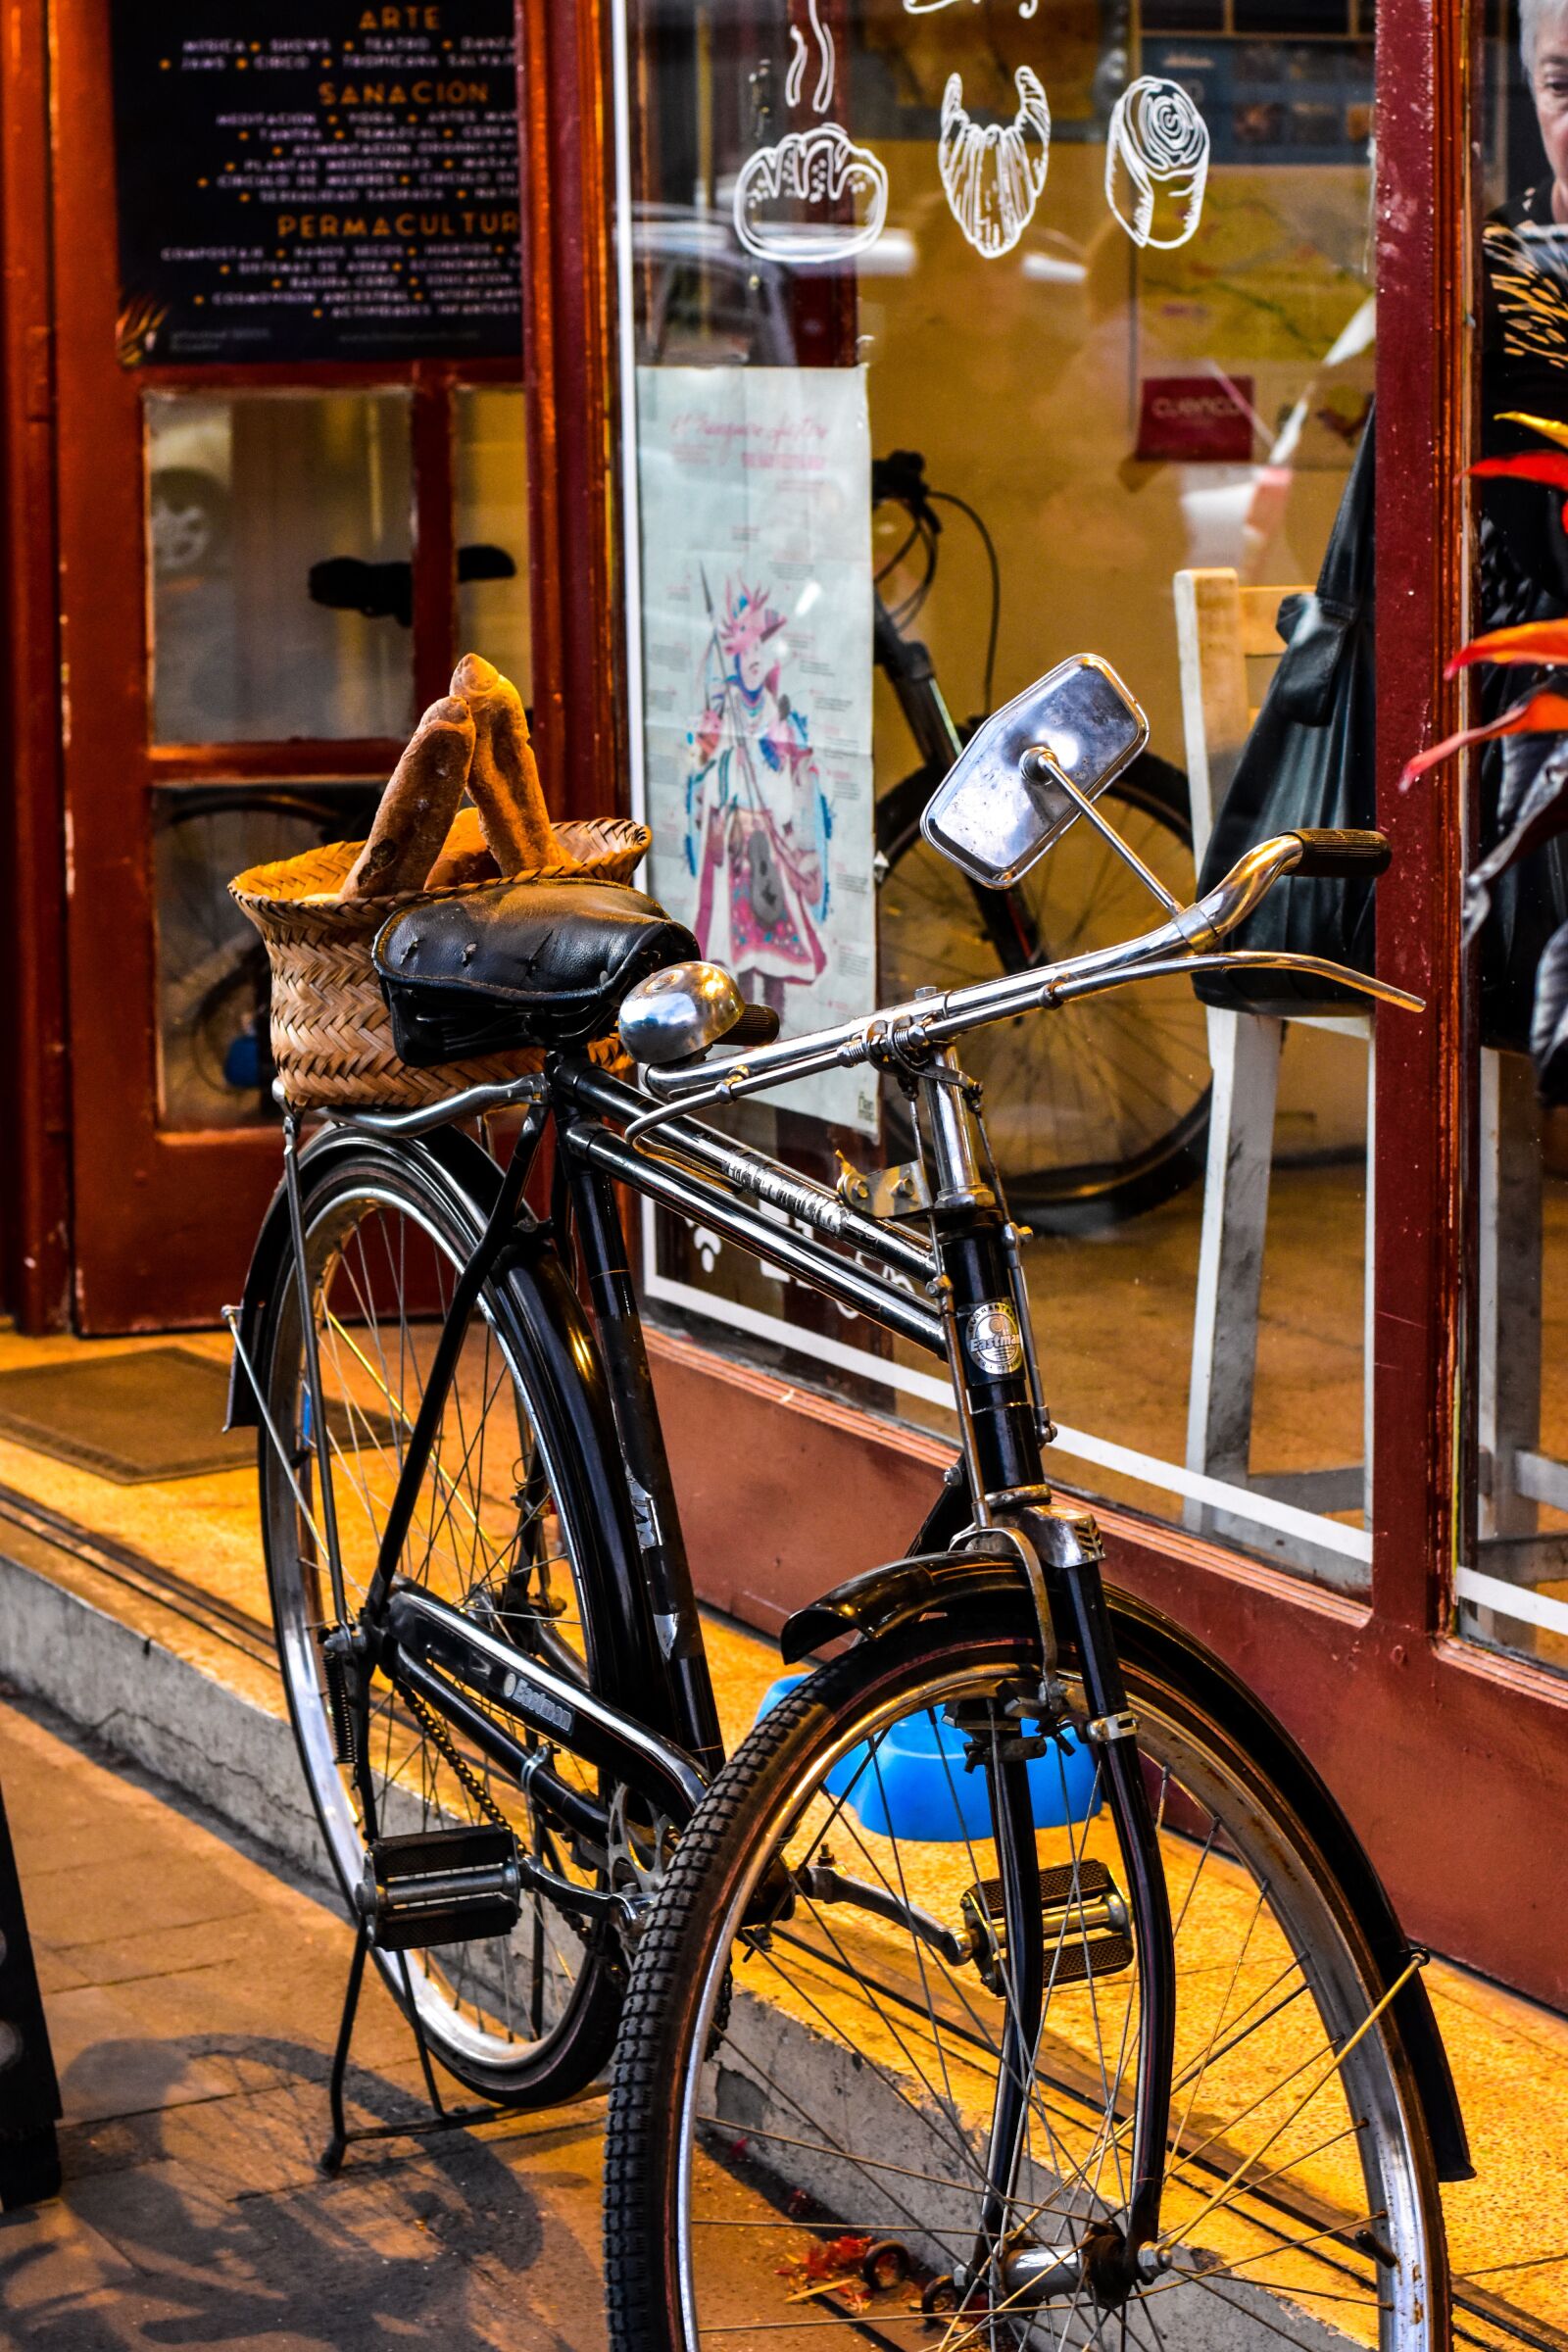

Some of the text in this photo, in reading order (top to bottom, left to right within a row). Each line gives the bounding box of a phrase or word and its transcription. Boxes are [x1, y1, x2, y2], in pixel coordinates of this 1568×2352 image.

[359, 5, 440, 30] ARTE
[270, 38, 331, 53] SHOWS
[364, 36, 430, 52] TEATRO
[253, 55, 310, 70] CIRCO
[342, 54, 440, 69] TROPICANA
[347, 112, 395, 124] YOGA
[426, 110, 476, 123] ARTES
[259, 127, 323, 141] TANTRA
[243, 158, 319, 172] PLANTAS
[325, 157, 432, 172] MEDICINALES
[296, 173, 318, 187] DE
[326, 172, 395, 186] MUJERES
[259, 188, 360, 204] SEXUALIDAD
[365, 187, 445, 202] SAGRADA
[160, 245, 266, 262] COMPOSTAJE
[352, 243, 404, 258] SECOS
[423, 242, 492, 256] HUERTOS
[237, 261, 313, 275] SISTEMAS
[317, 261, 338, 274] DE
[288, 275, 350, 290] BASURA
[354, 274, 400, 288] CERO
[321, 289, 410, 304] ANCESTRAL
[330, 304, 432, 318] ACTIVIDADES
[512, 1678, 573, 1733] Eastman
